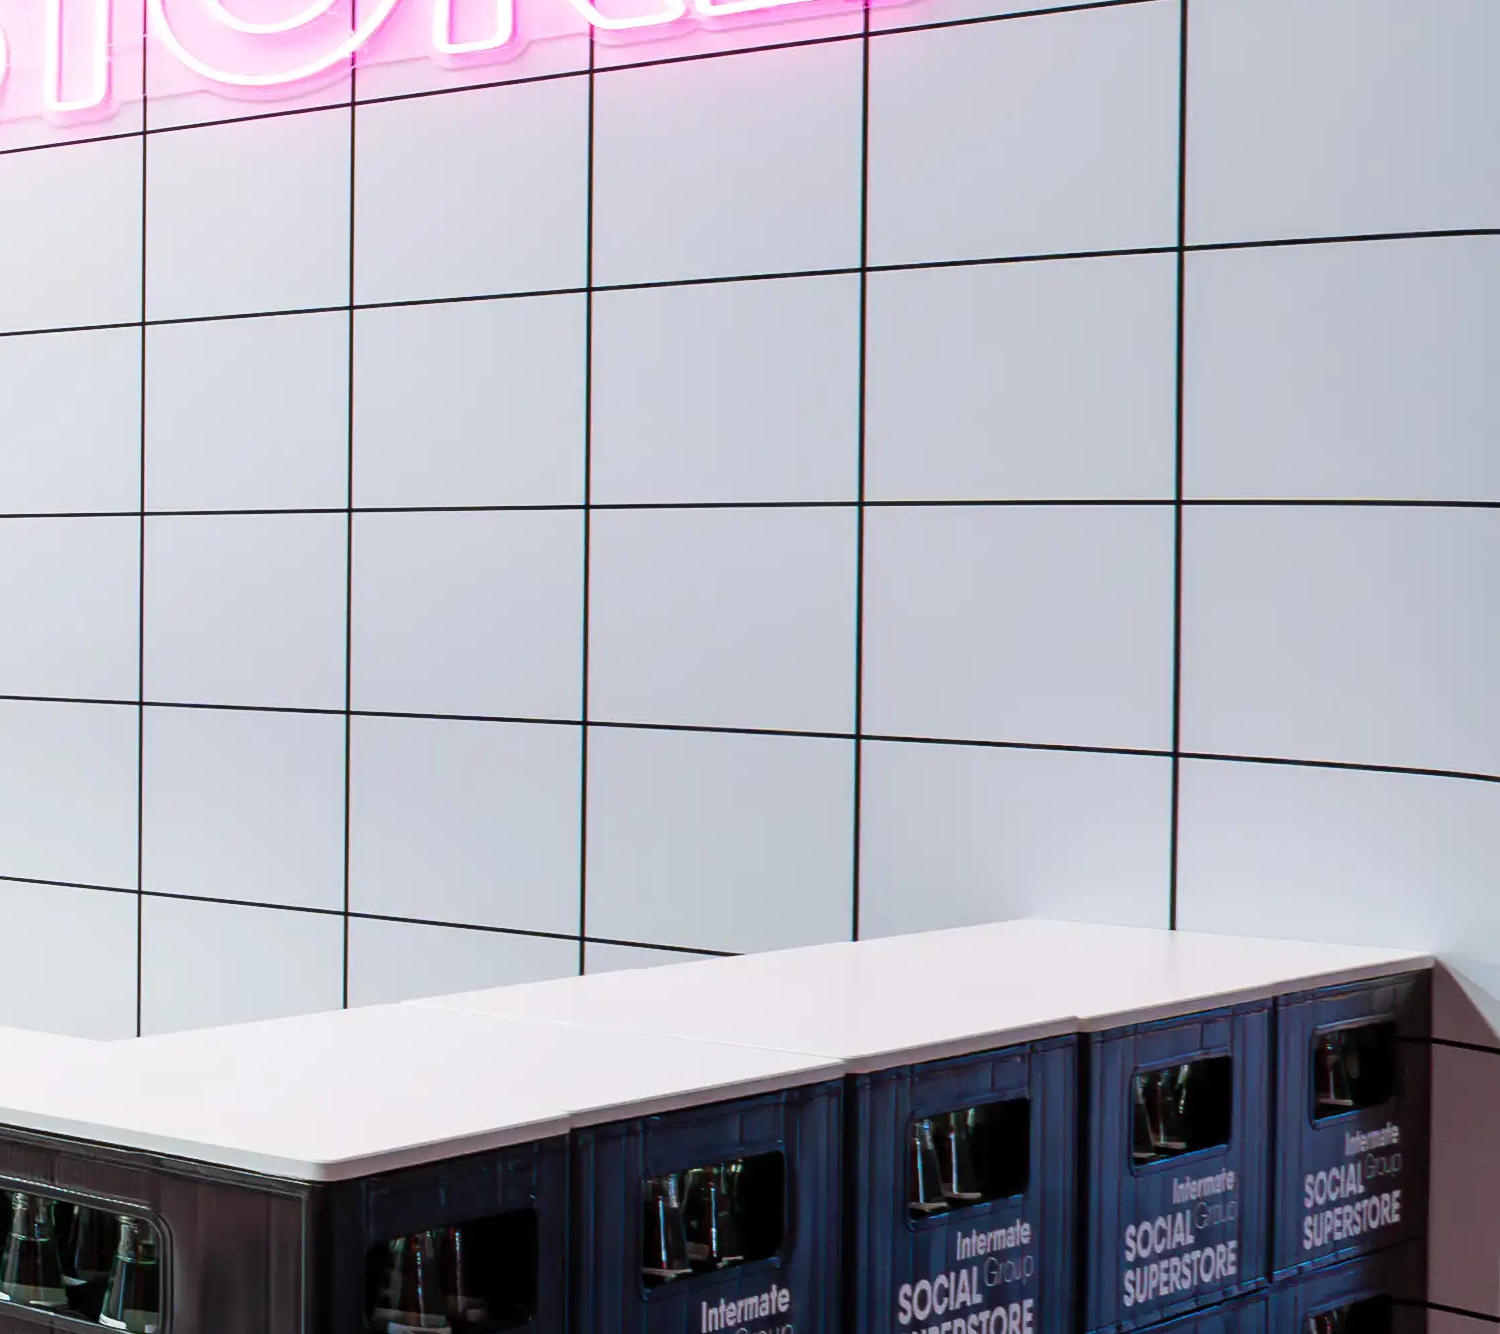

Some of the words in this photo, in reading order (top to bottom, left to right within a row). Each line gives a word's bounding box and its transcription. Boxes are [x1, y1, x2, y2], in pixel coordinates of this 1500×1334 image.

[1196, 1201, 1237, 1229] Group
[1303, 1162, 1364, 1218] SOCIAL
[1125, 1210, 1194, 1262] SOCIAL
[1303, 1190, 1400, 1250] SUPERSTORE
[899, 1266, 982, 1324] SOCIAL
[985, 1255, 1034, 1286] Group
[1124, 1240, 1237, 1306] SUPERSTORE
